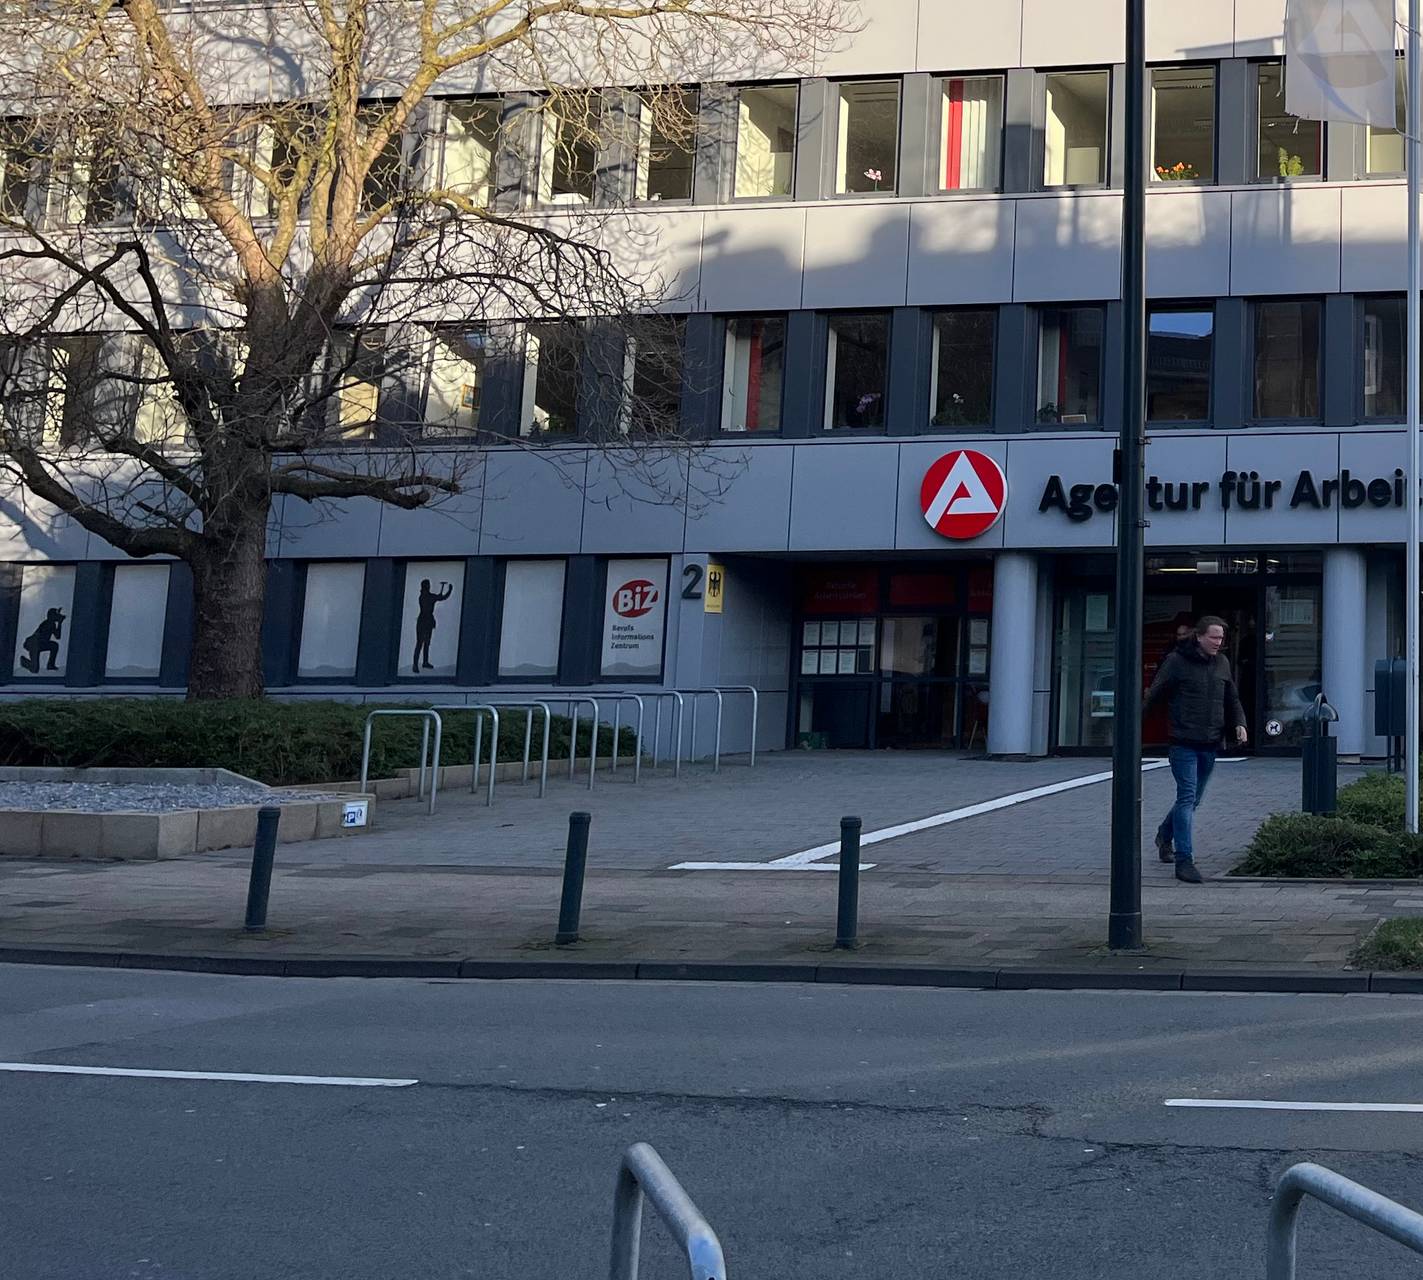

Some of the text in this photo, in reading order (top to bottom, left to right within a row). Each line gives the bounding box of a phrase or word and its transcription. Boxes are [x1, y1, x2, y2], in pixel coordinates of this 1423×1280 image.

[1038, 468, 1423, 522] Agetur für Arbei
[681, 564, 704, 599] 2
[617, 585, 658, 613] BiZ
[610, 641, 640, 650] Zentrum
